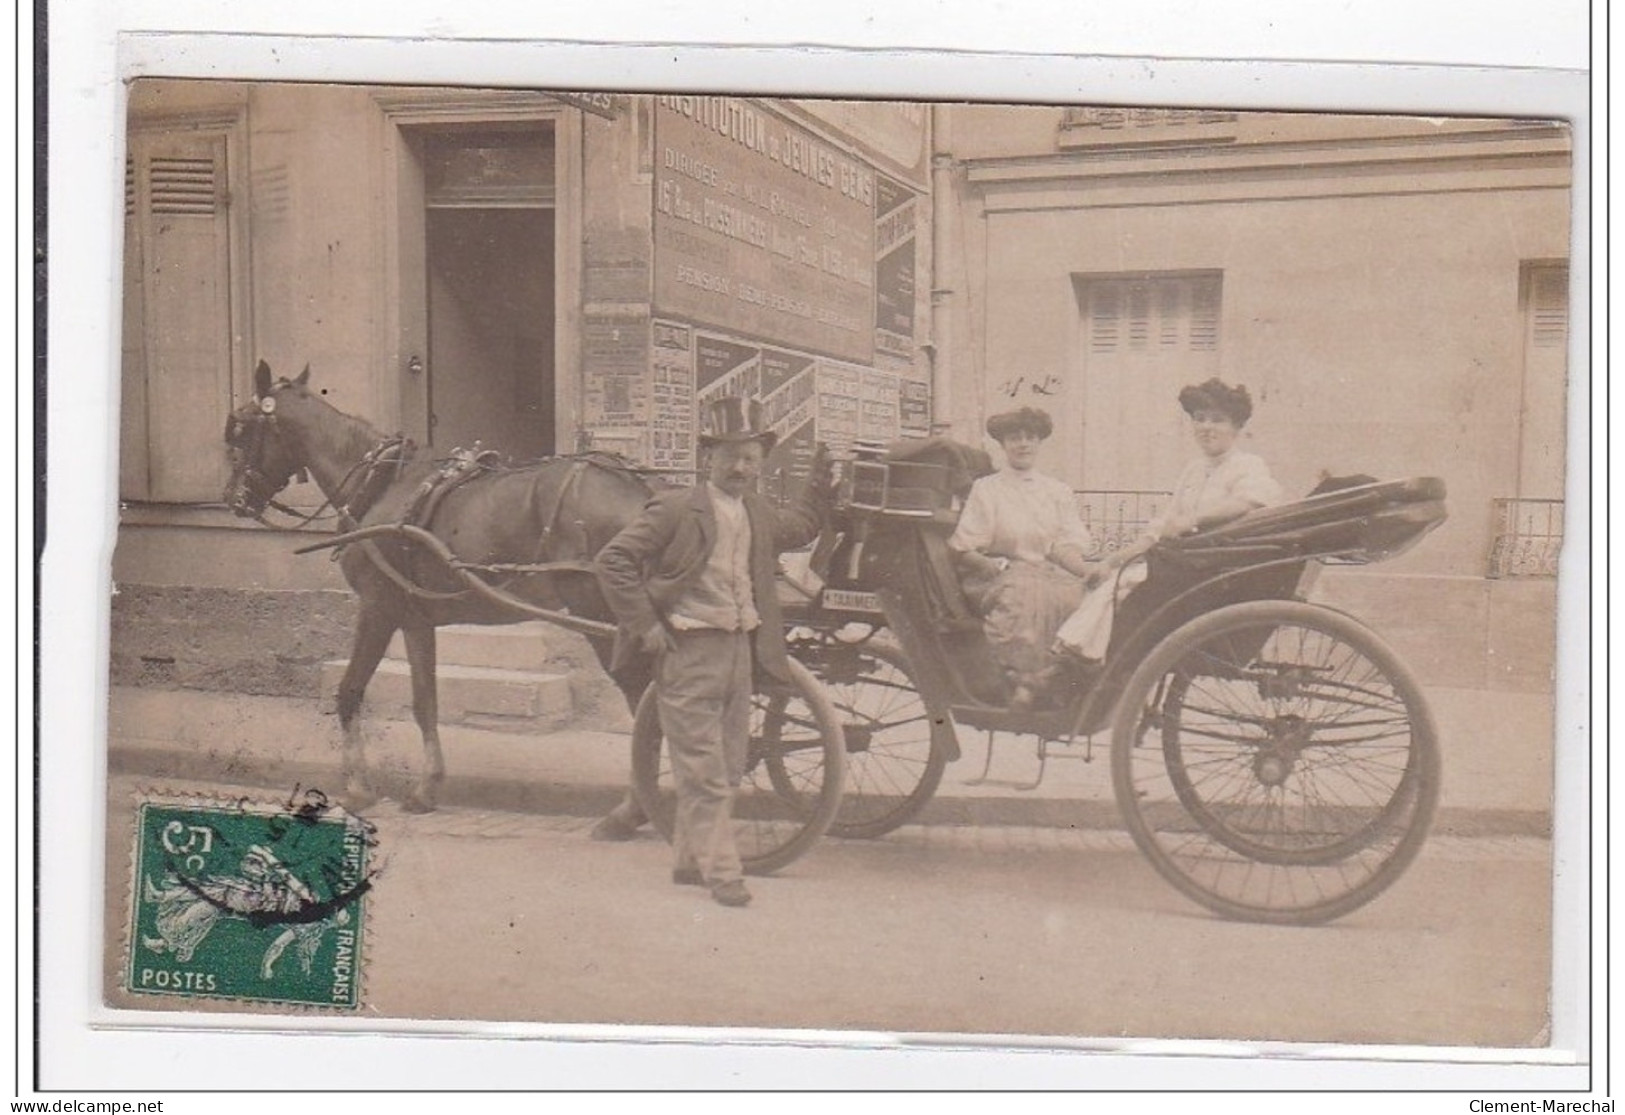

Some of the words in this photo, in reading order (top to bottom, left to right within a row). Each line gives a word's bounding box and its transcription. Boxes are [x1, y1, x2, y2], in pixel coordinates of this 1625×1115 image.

[660, 96, 766, 156] STITUTION
[782, 130, 834, 190] JEUNES
[840, 162, 872, 208] GENS
[141, 967, 217, 992] POSTES
[332, 929, 354, 1002] FRANÇAISE
